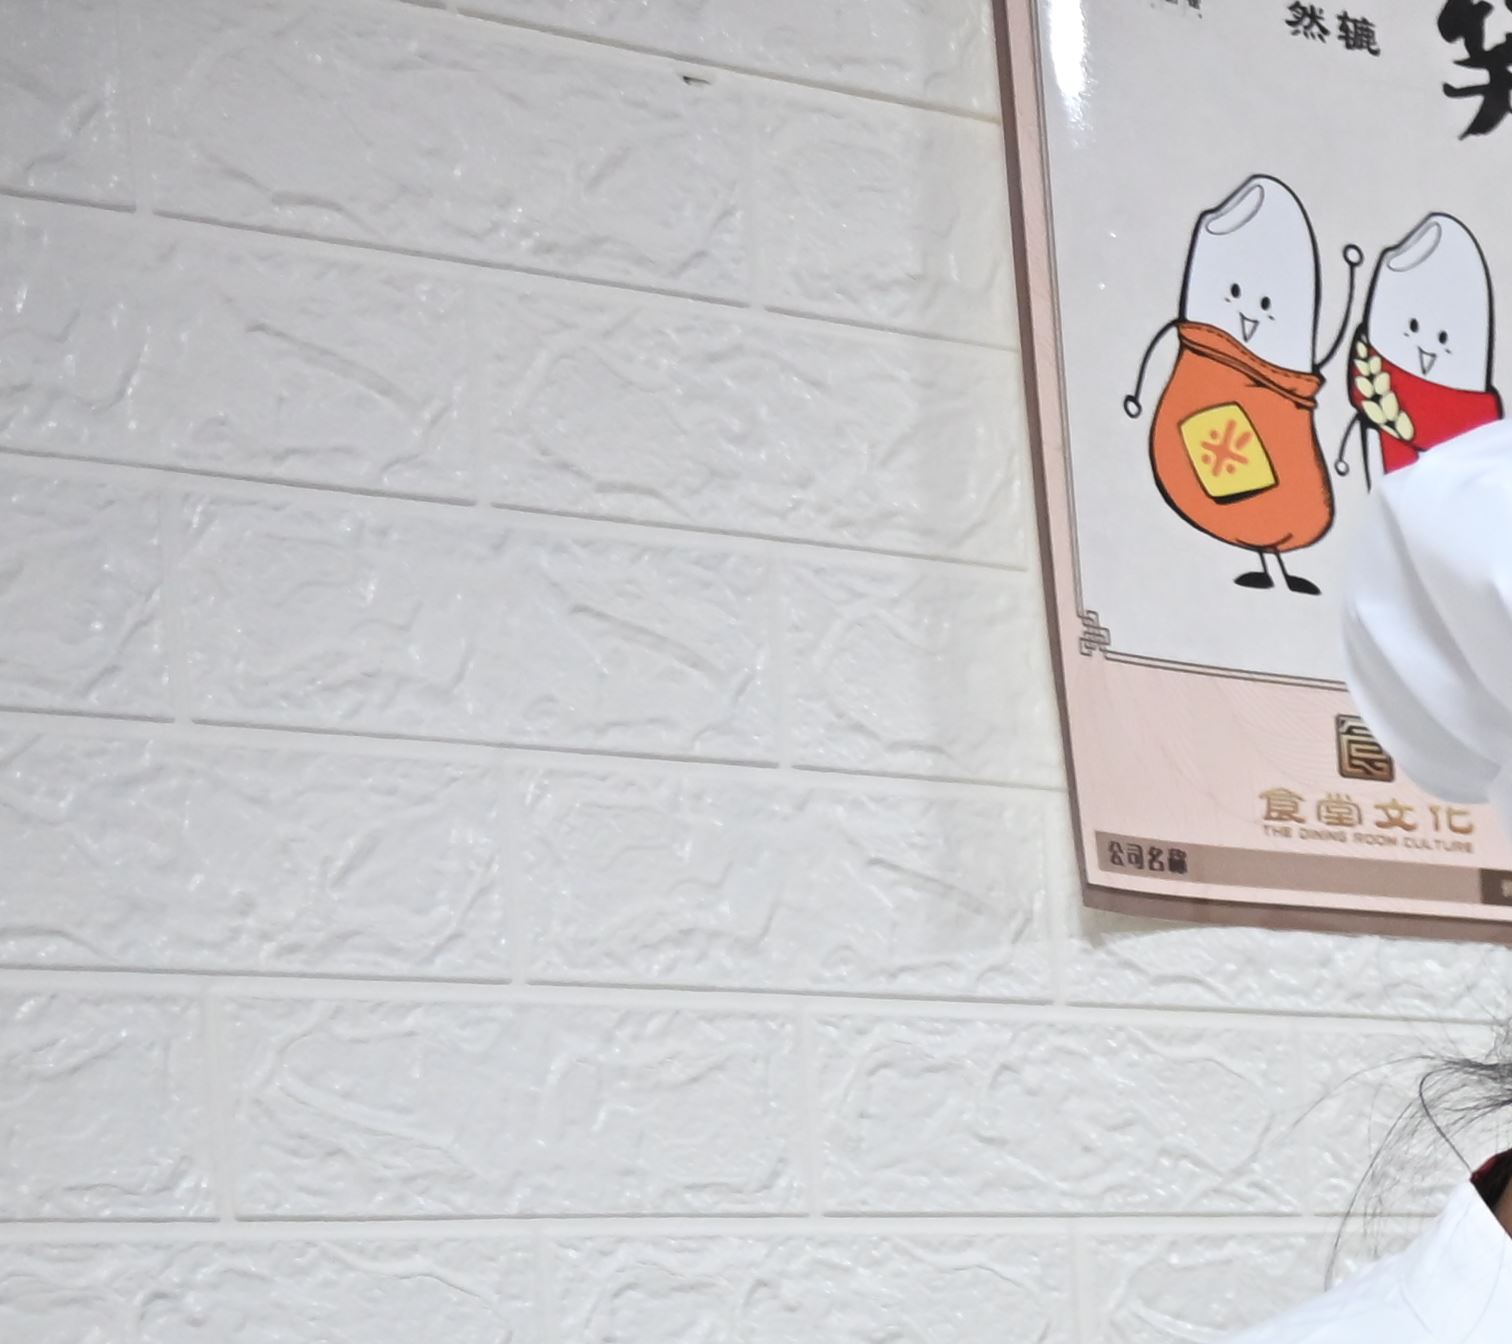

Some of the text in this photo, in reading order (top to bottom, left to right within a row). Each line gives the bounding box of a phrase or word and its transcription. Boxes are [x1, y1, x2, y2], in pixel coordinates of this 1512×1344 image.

[1259, 788, 1475, 834] 食堂文化
[1264, 825, 1474, 854] THE DINING ROOM CULTURE
